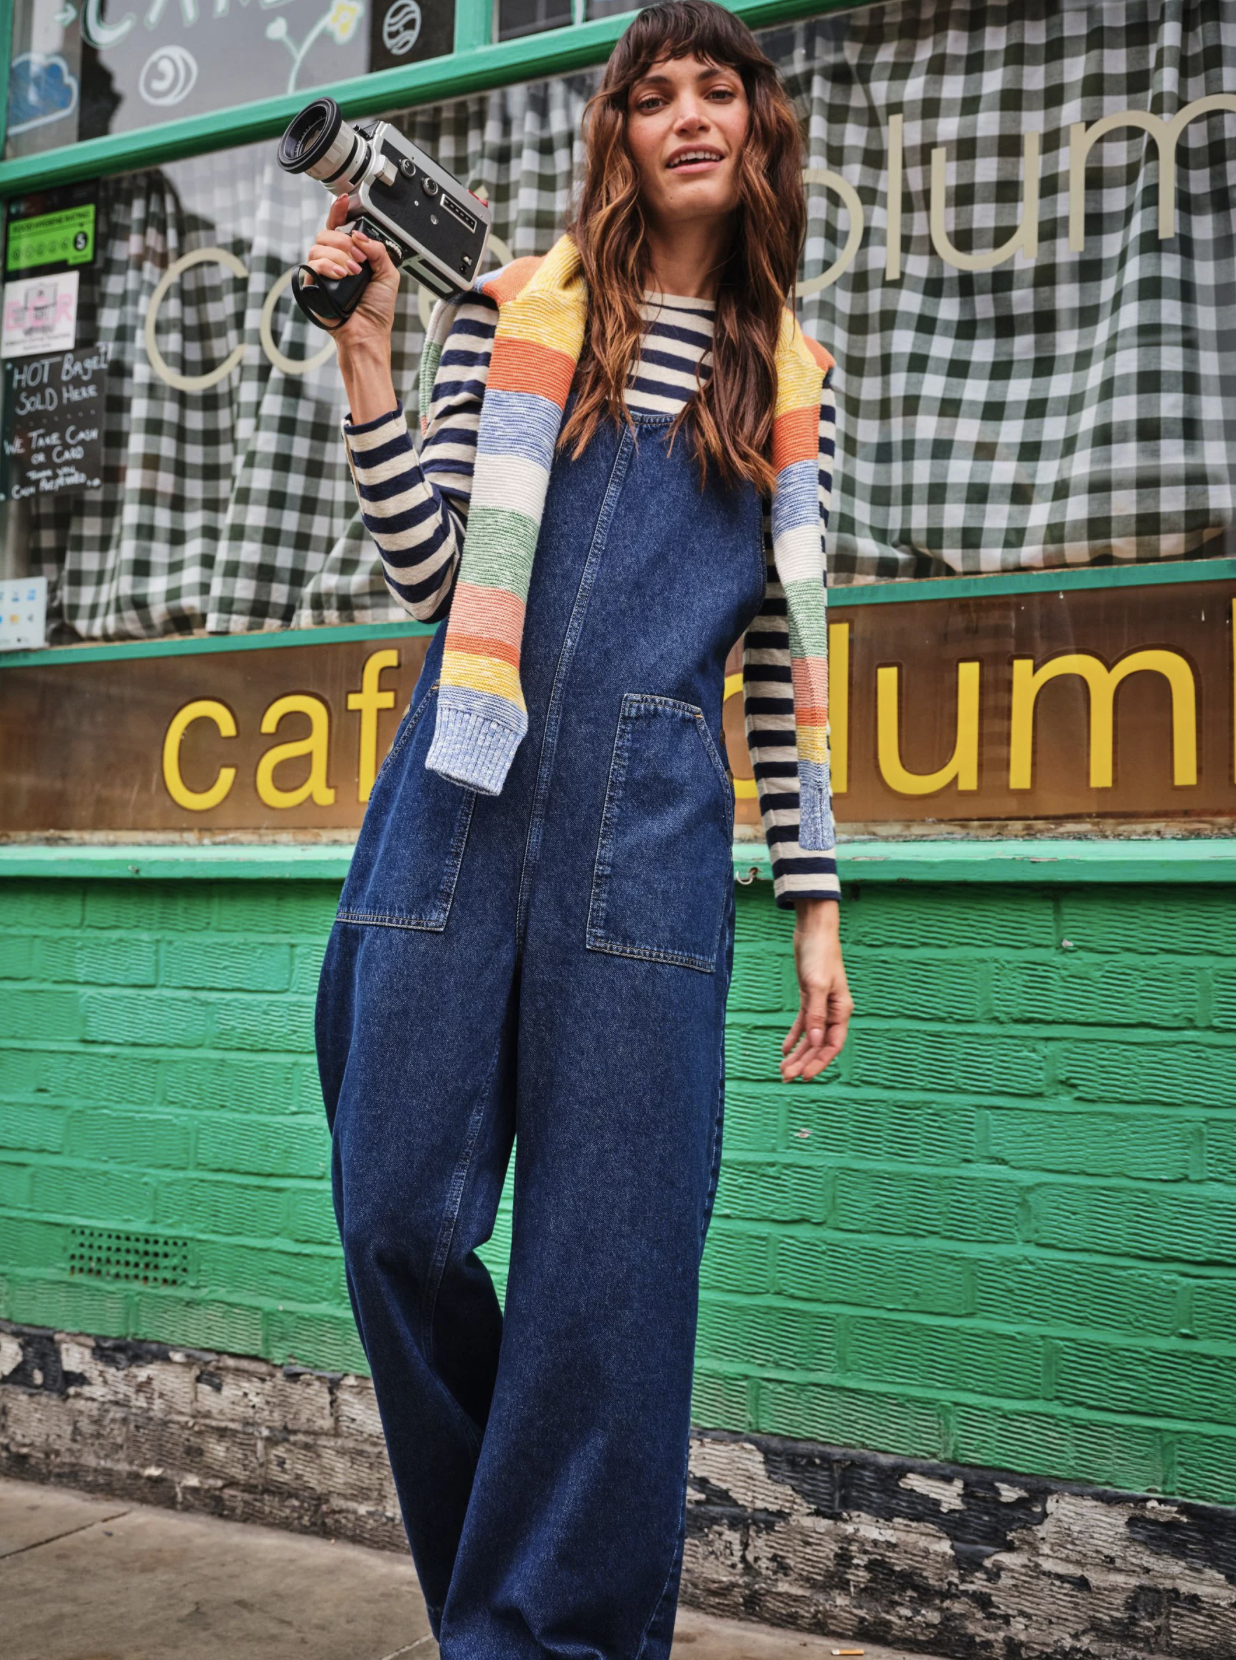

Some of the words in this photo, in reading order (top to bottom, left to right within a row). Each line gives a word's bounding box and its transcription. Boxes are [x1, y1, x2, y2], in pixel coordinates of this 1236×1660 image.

[75, 232, 86, 250] 5
[12, 356, 62, 389] HOT
[15, 387, 58, 416] SOLD
